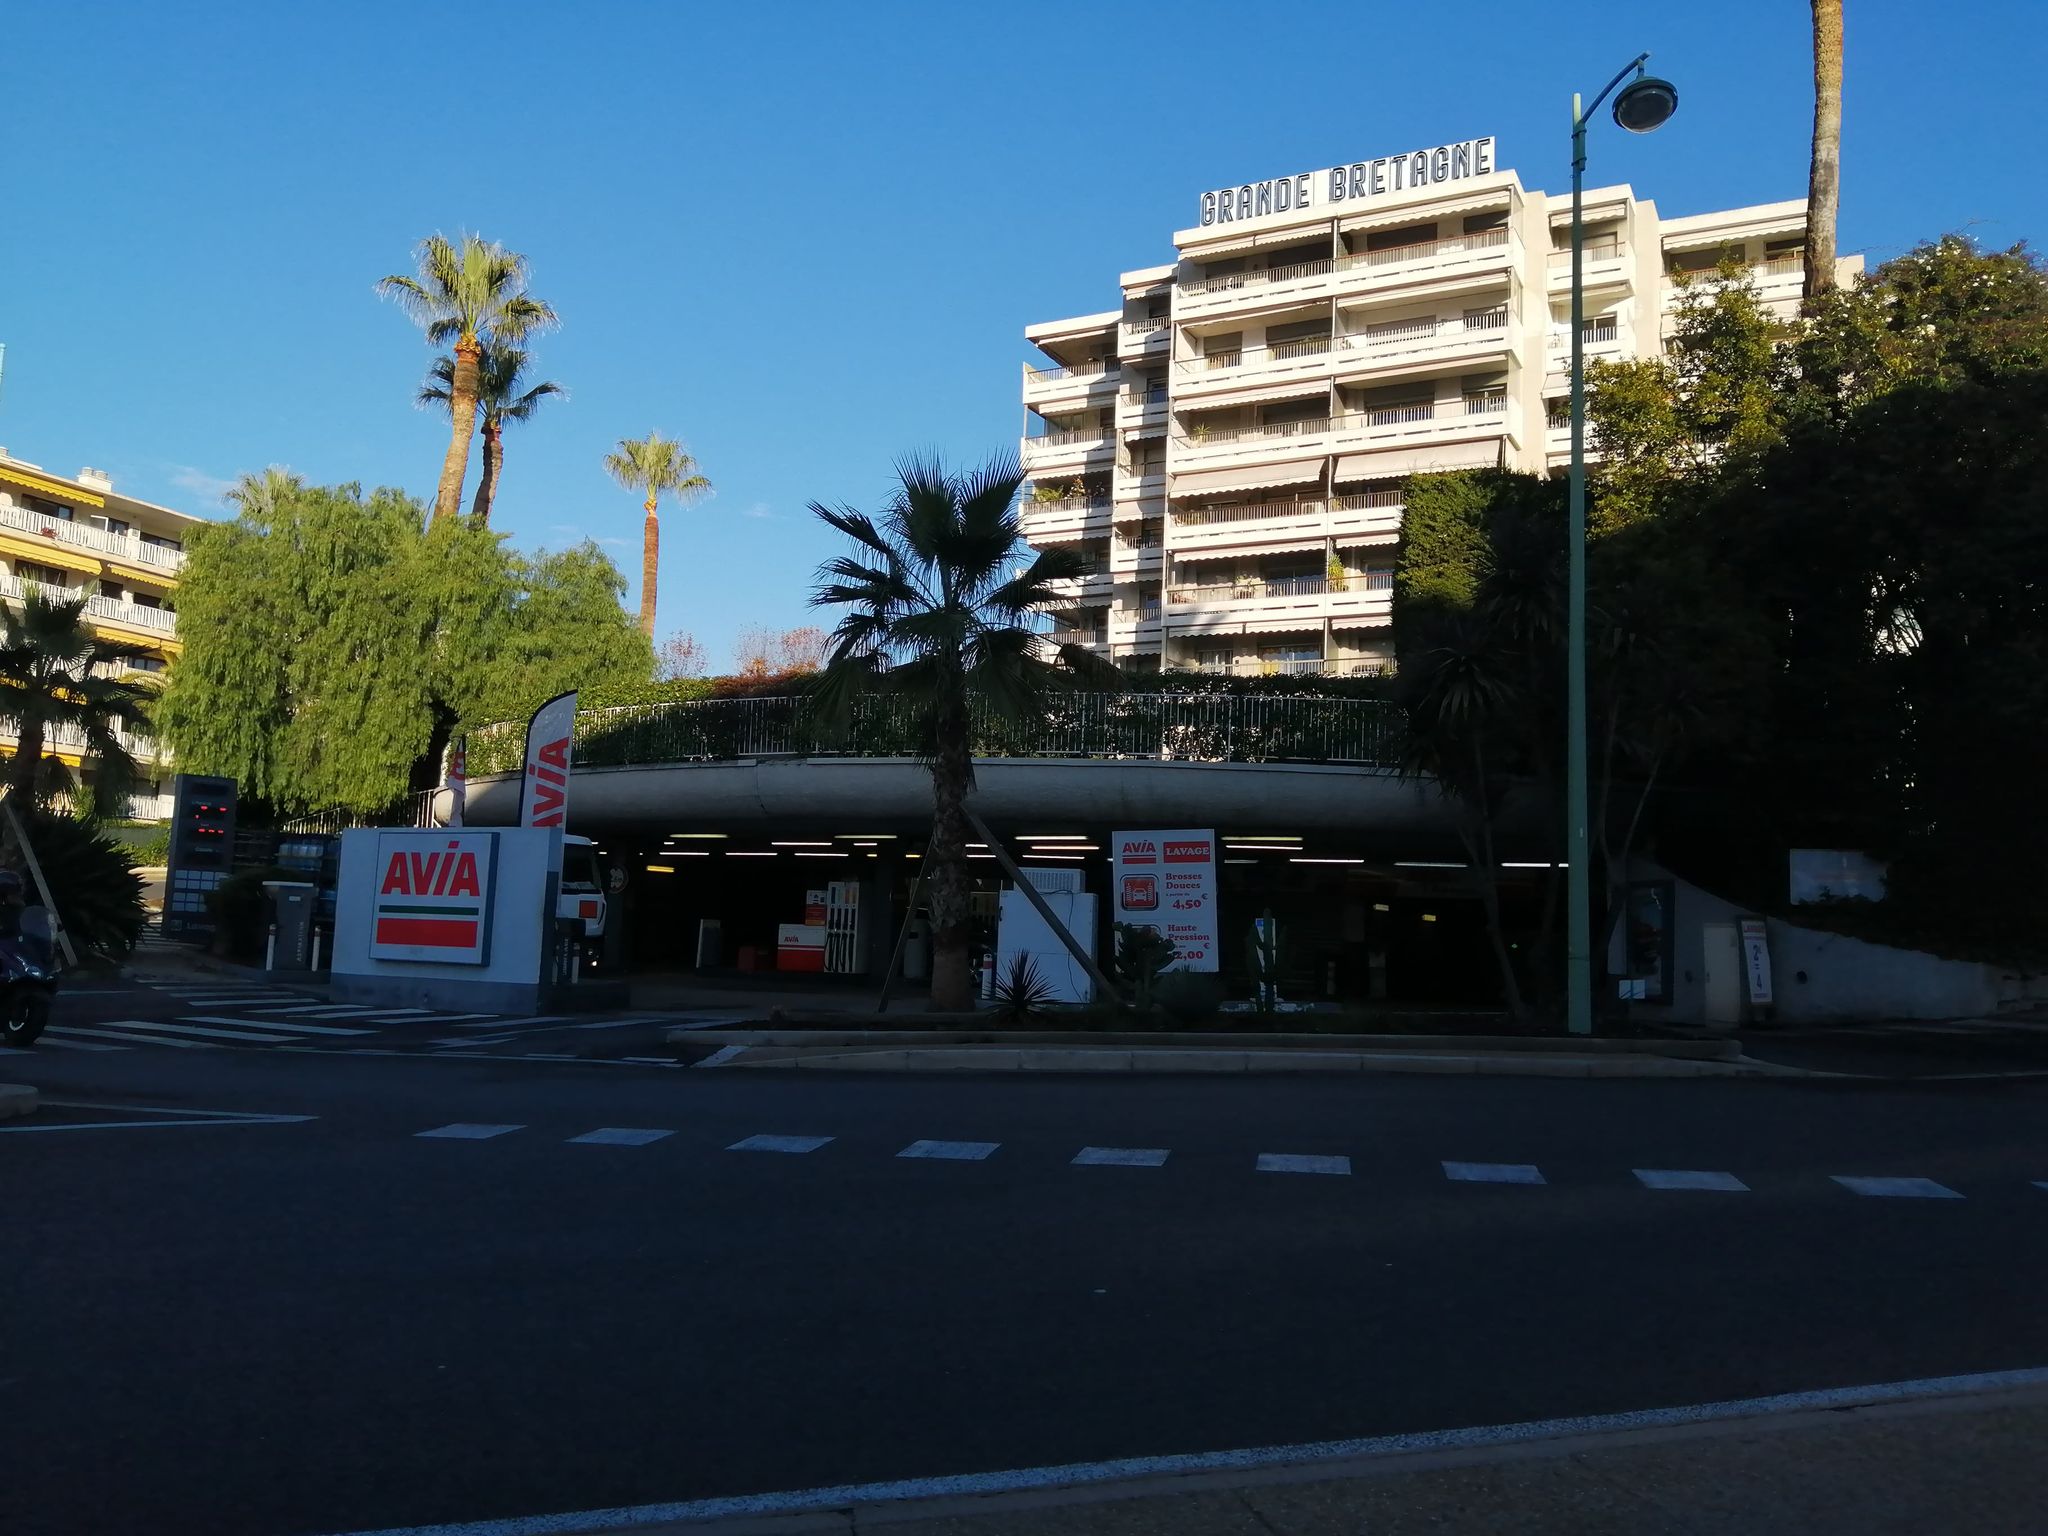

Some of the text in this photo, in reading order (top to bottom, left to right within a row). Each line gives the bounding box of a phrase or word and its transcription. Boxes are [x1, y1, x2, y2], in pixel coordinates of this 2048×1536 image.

[1200, 137, 1491, 227] GRANDE BRETAGNE
[1122, 840, 1156, 853] AVIA
[1166, 847, 1209, 856] LAVAGE
[381, 841, 480, 897] AVIA
[1168, 924, 1197, 932] Haute
[1168, 933, 1210, 941] Pression
